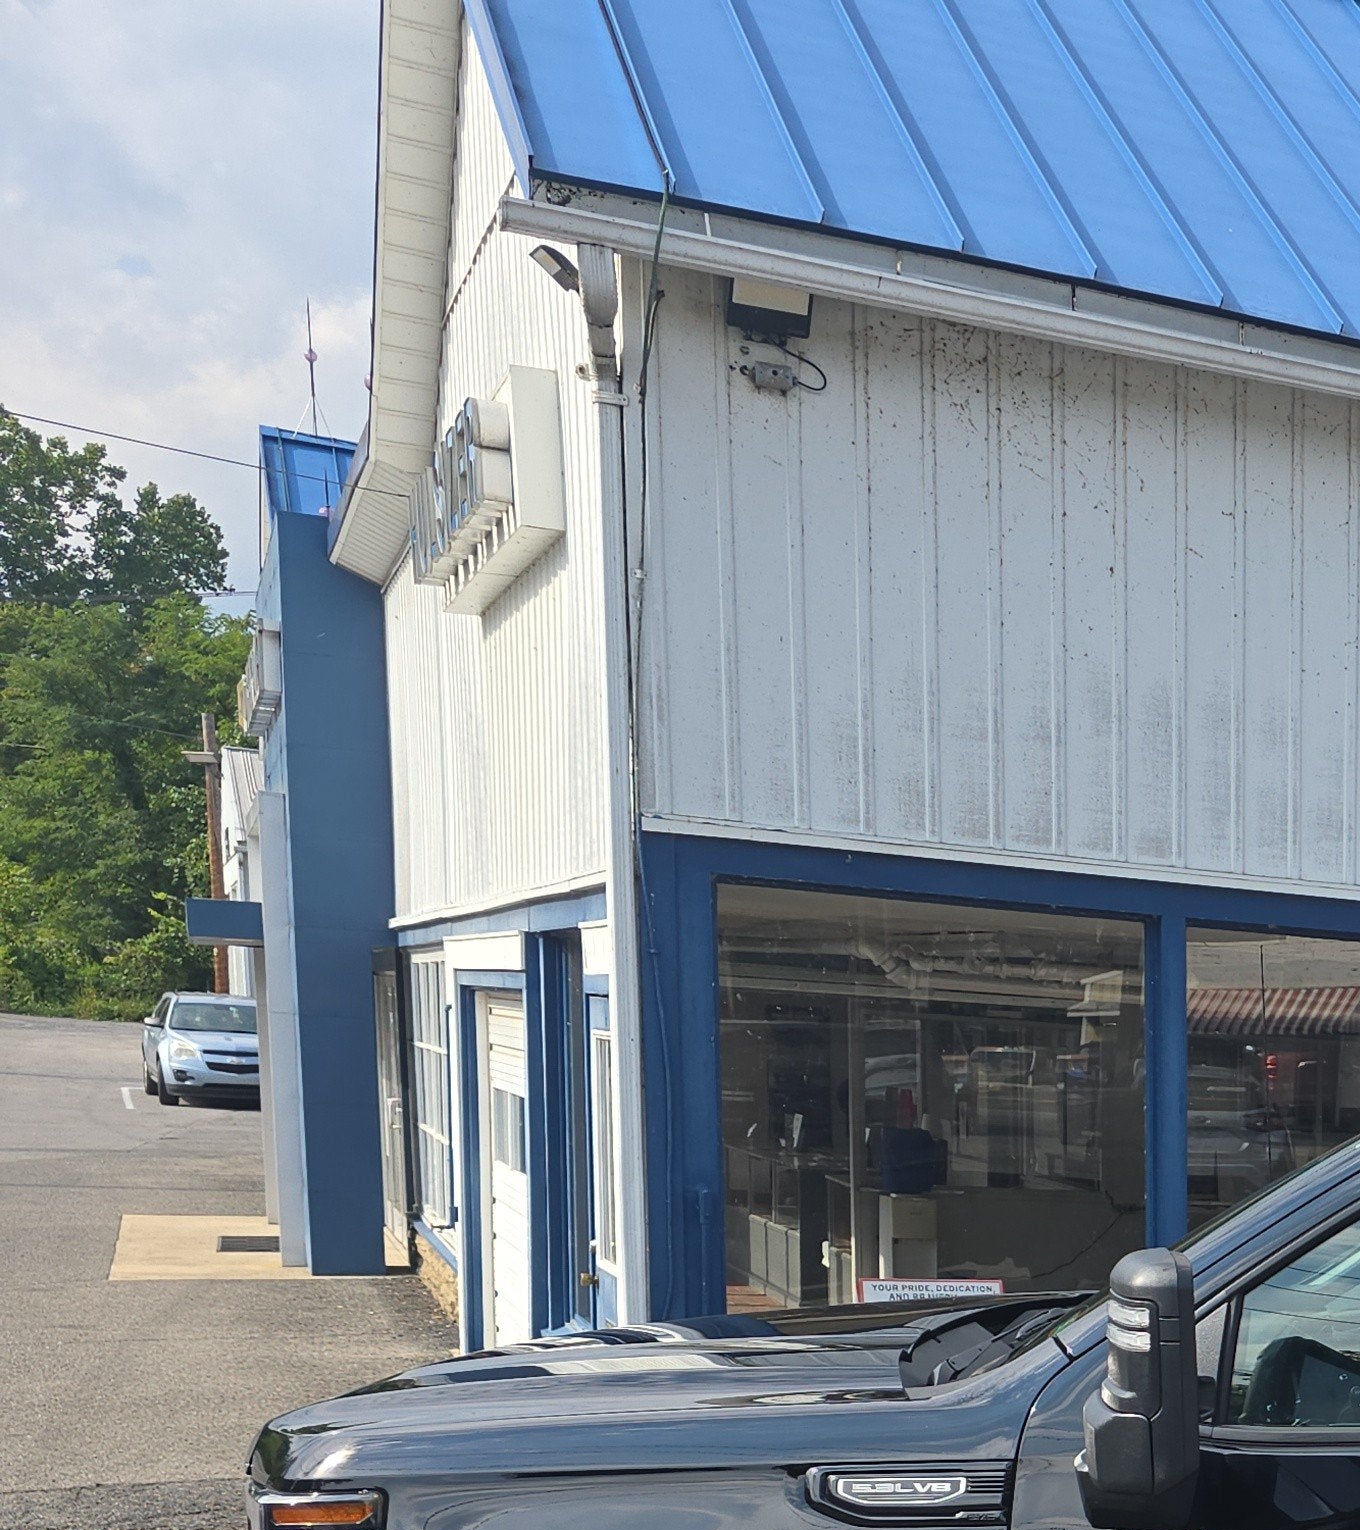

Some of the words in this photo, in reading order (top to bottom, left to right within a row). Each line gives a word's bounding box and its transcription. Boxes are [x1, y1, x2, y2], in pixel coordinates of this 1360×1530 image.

[871, 1283, 899, 1292] YOUR
[901, 1283, 934, 1293] PRIDE,
[936, 1284, 996, 1295] DEDICATION,
[889, 1292, 910, 1301] AND
